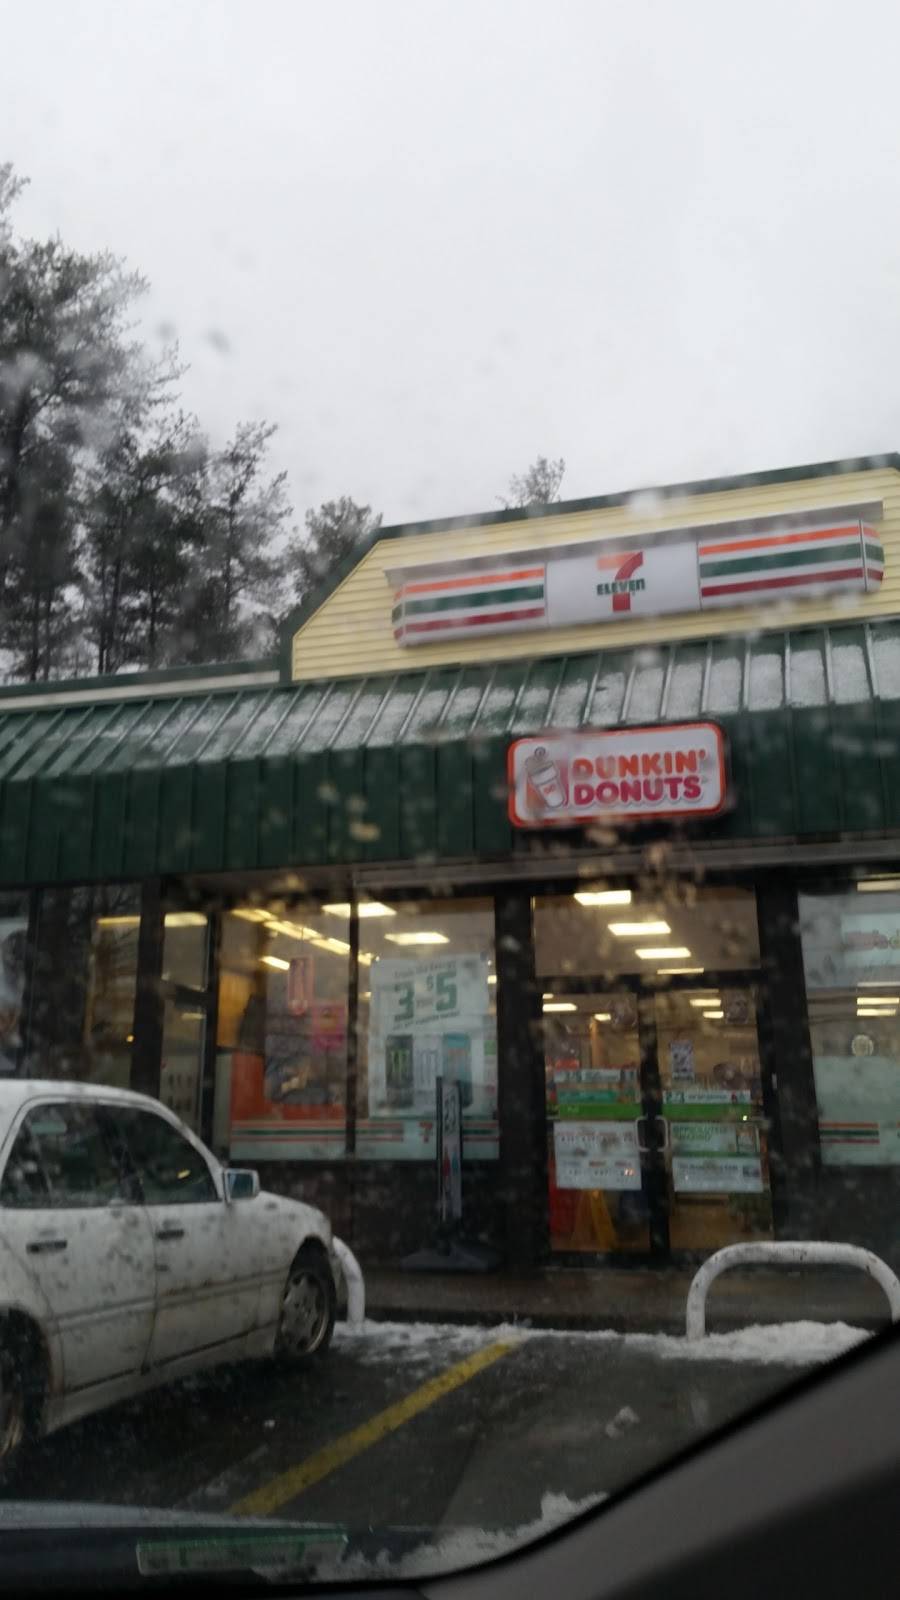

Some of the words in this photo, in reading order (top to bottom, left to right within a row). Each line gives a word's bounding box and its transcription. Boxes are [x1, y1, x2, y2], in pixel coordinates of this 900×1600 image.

[597, 551, 643, 611] 7
[571, 749, 707, 779] DUNKIN'
[573, 776, 702, 806] DONUTS
